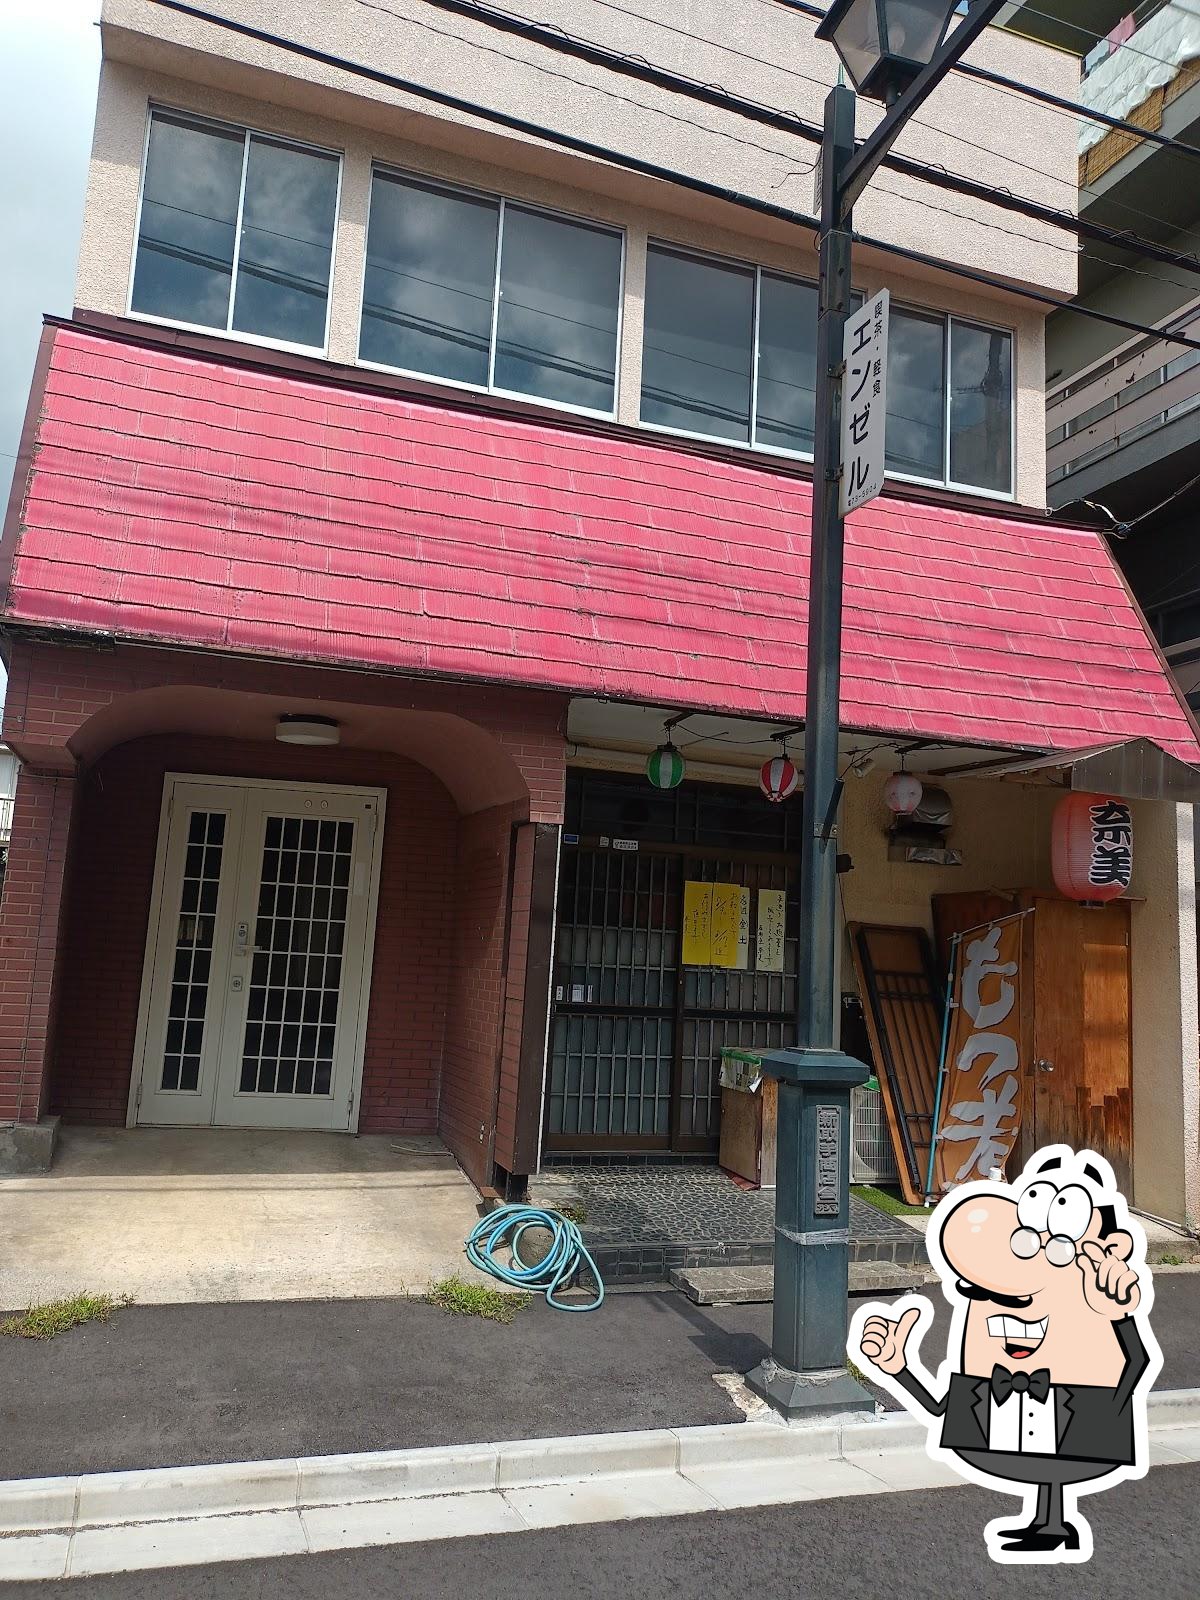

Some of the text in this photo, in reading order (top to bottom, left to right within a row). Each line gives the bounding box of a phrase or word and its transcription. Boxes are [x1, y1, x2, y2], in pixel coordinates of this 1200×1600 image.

[848, 318, 872, 497] エンゼル
[1088, 800, 1133, 888] 奈美
[940, 926, 1019, 1188] もつ煮
